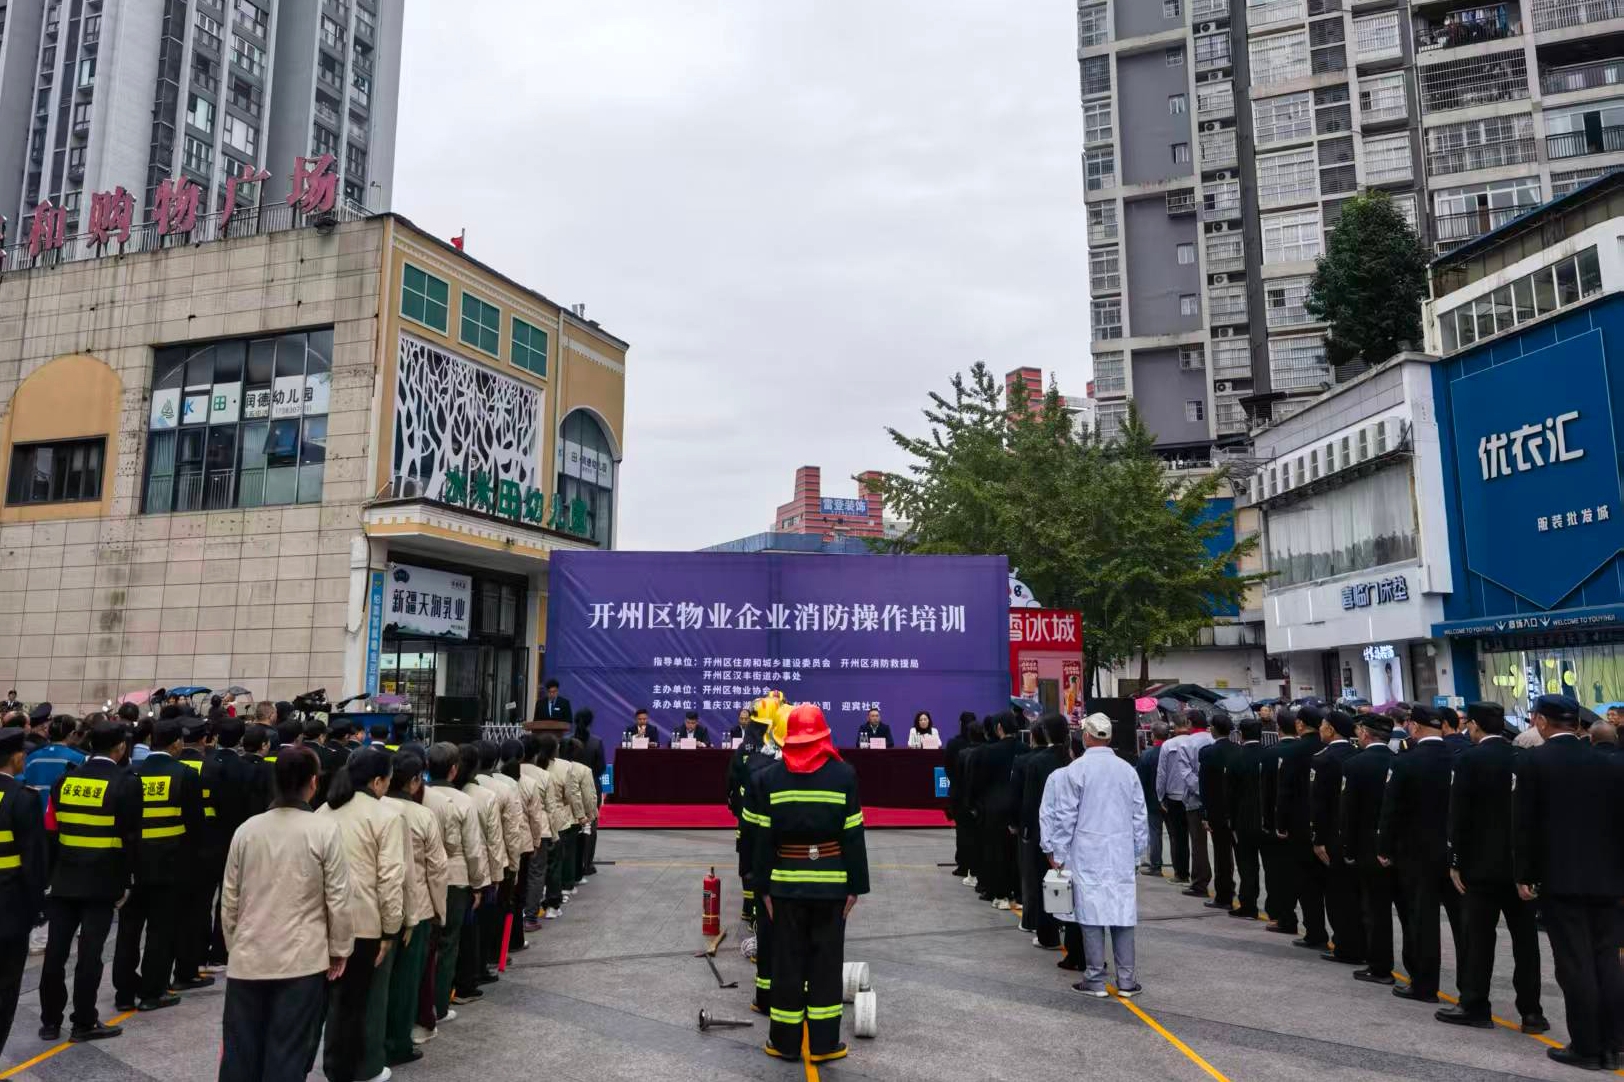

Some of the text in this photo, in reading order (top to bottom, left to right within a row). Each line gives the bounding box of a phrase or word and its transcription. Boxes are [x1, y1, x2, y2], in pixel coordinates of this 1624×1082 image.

[0, 153, 339, 266] 和购物广场
[1478, 410, 1584, 481] 优衣汇
[1537, 505, 1609, 532] 服装批发城
[391, 589, 466, 621] 新疆天润乳业
[1341, 575, 1409, 610] 喜临门床垫
[587, 601, 967, 634] 开州区物业企业消防操作培训
[702, 670, 802, 682] 开州区汉丰街道办事处
[703, 657, 831, 669] 开州区住房和城乡建设委员会
[840, 657, 919, 669] 开州区消防救援局
[702, 684, 771, 696] 开州区物业协会
[841, 700, 882, 712] 迎宾社区
[62, 784, 103, 799] 保安巡逻
